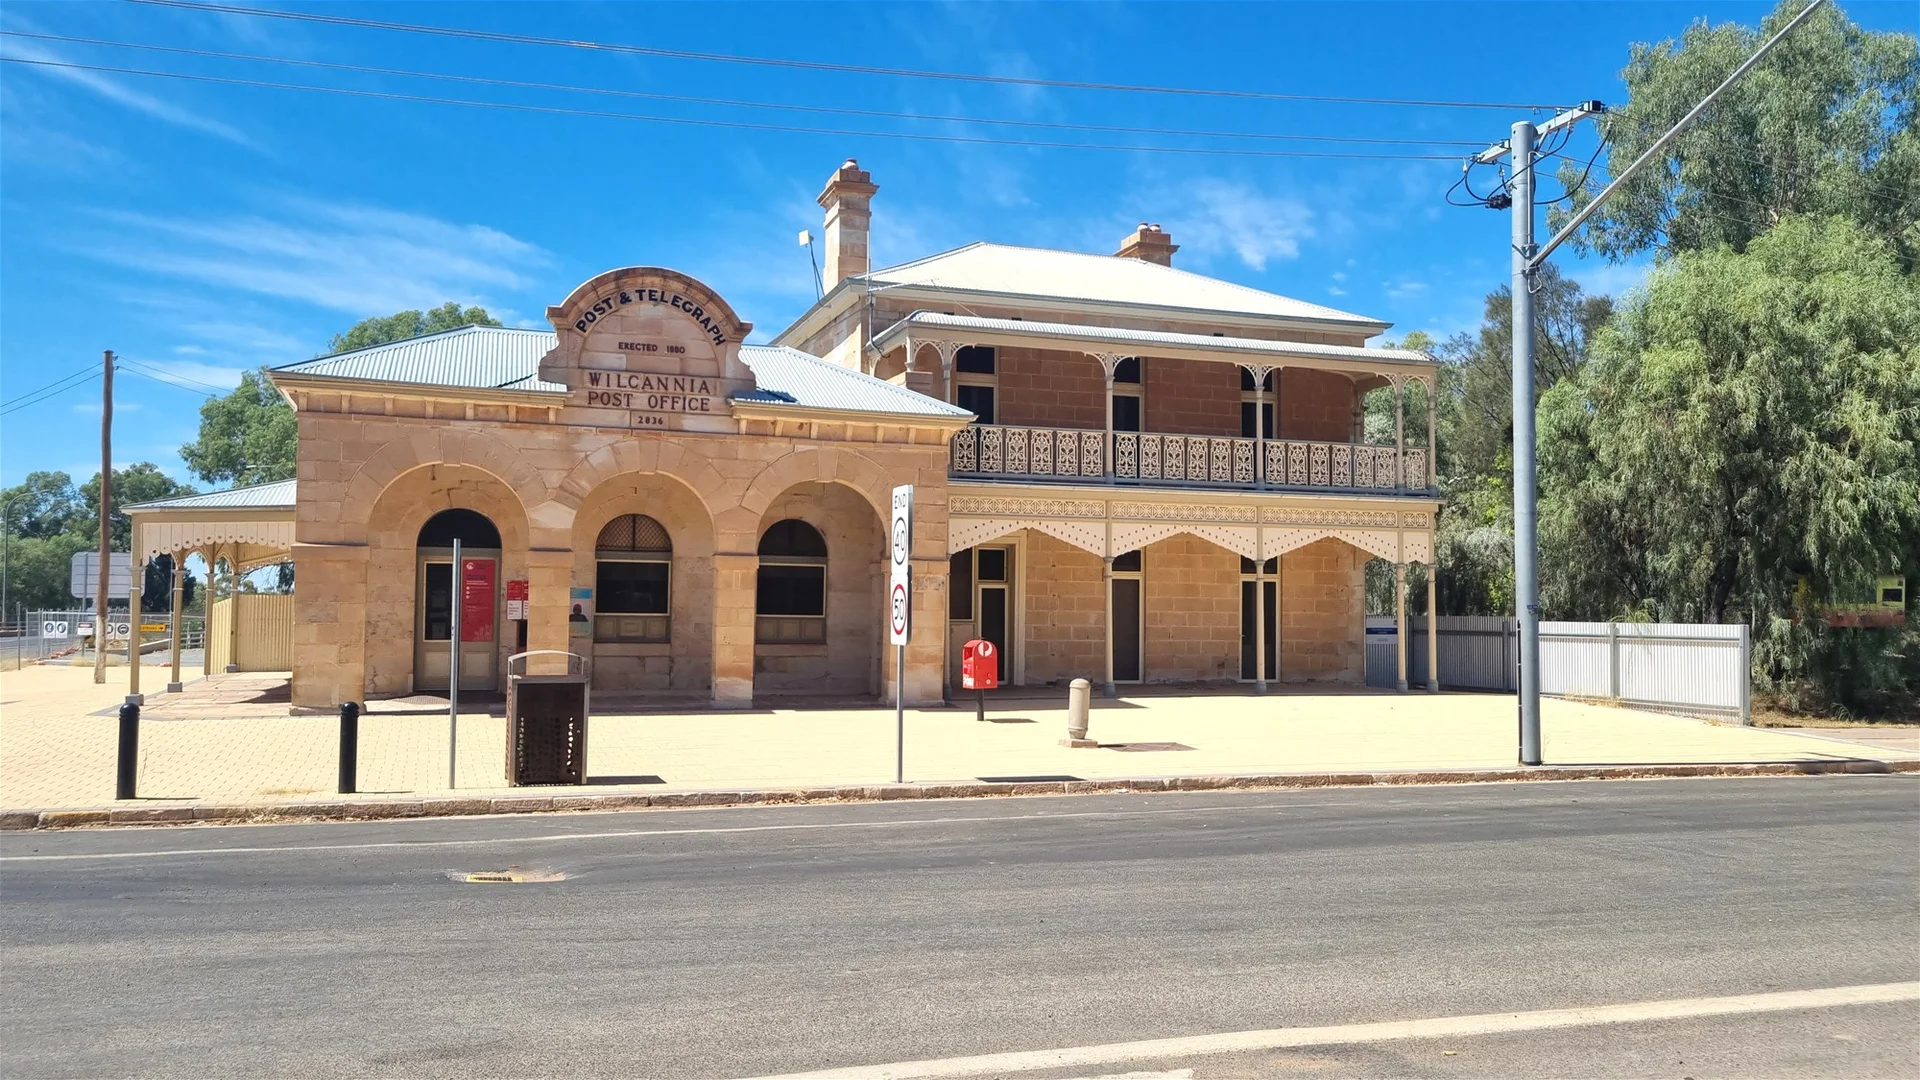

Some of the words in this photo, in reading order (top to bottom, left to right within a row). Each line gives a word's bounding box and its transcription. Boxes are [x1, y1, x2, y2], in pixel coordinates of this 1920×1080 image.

[575, 297, 612, 333] POST
[619, 291, 632, 304] &
[635, 289, 726, 346] TELEGRAPH
[618, 341, 658, 352] ERECTED
[666, 345, 685, 354] 1880
[589, 372, 710, 394] WILCANNIA
[587, 391, 633, 408] POST
[648, 394, 710, 411] OFFICE
[638, 416, 664, 425] 2836
[895, 493, 906, 509] END
[895, 530, 905, 551] 40
[894, 598, 905, 620] 50
